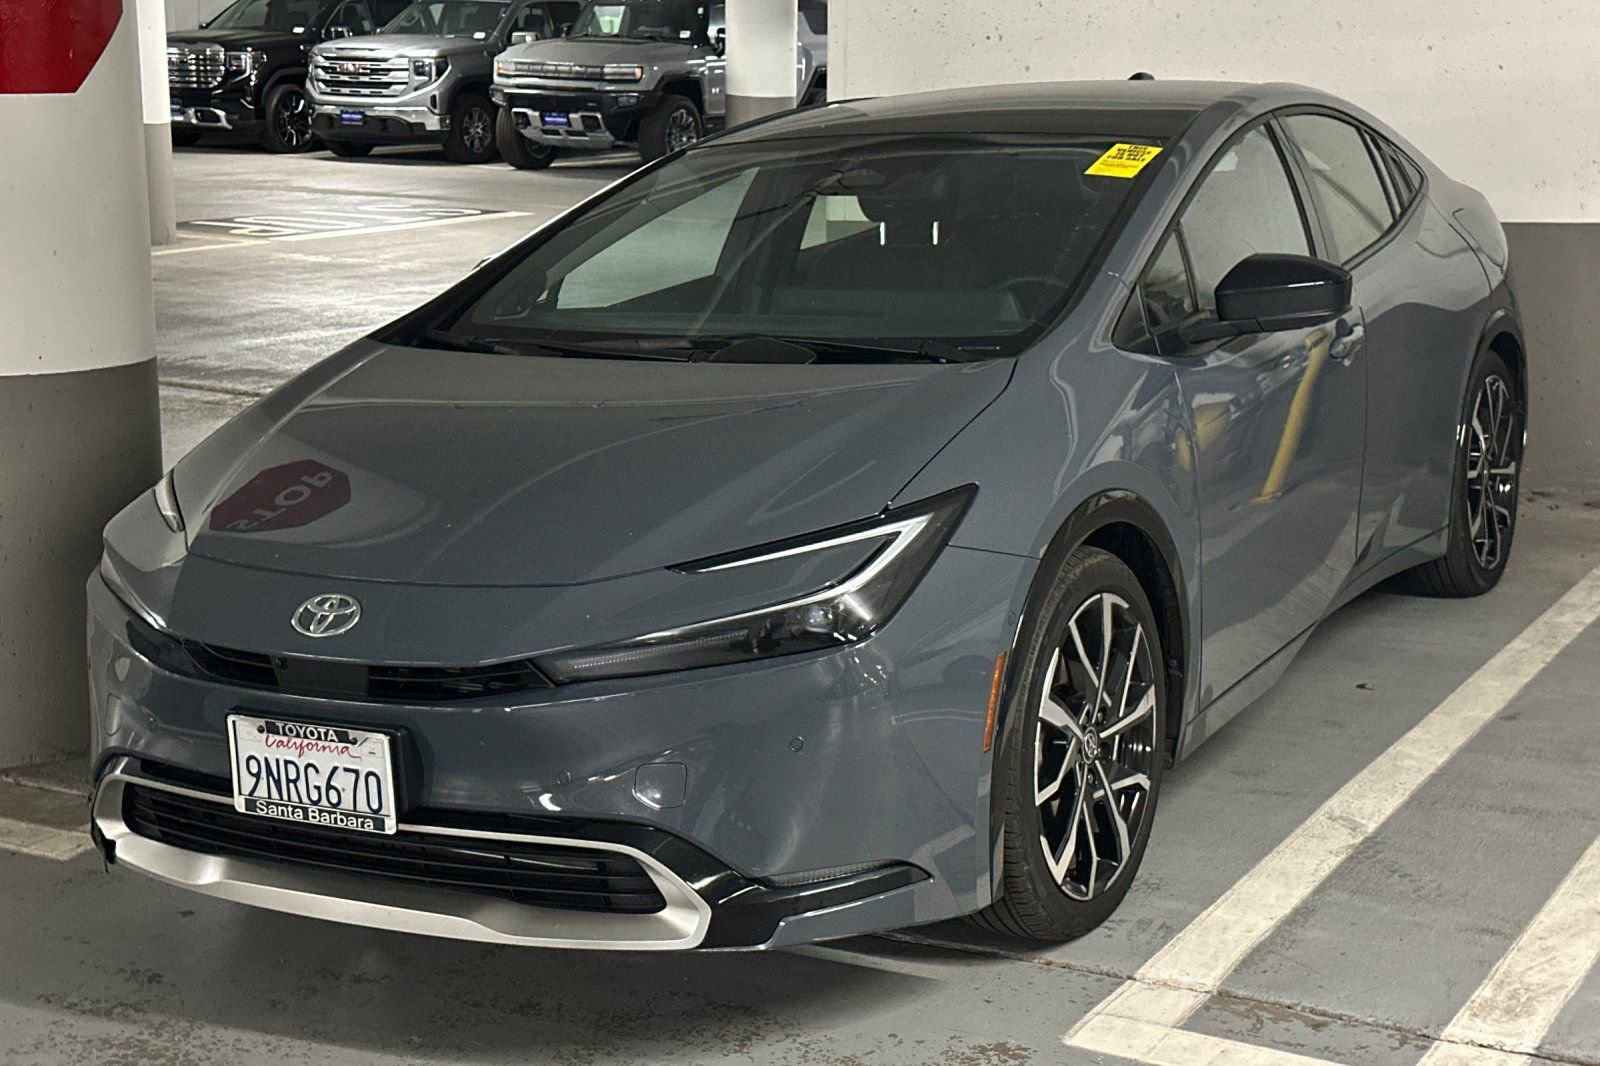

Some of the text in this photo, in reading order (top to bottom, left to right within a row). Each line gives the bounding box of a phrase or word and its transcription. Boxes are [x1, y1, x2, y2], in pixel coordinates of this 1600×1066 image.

[189, 204, 482, 238] STOP
[264, 734, 362, 759] California
[275, 722, 338, 742] TOYOTA
[245, 754, 384, 815] 9NRG670
[256, 800, 375, 831] Santa Barbara
